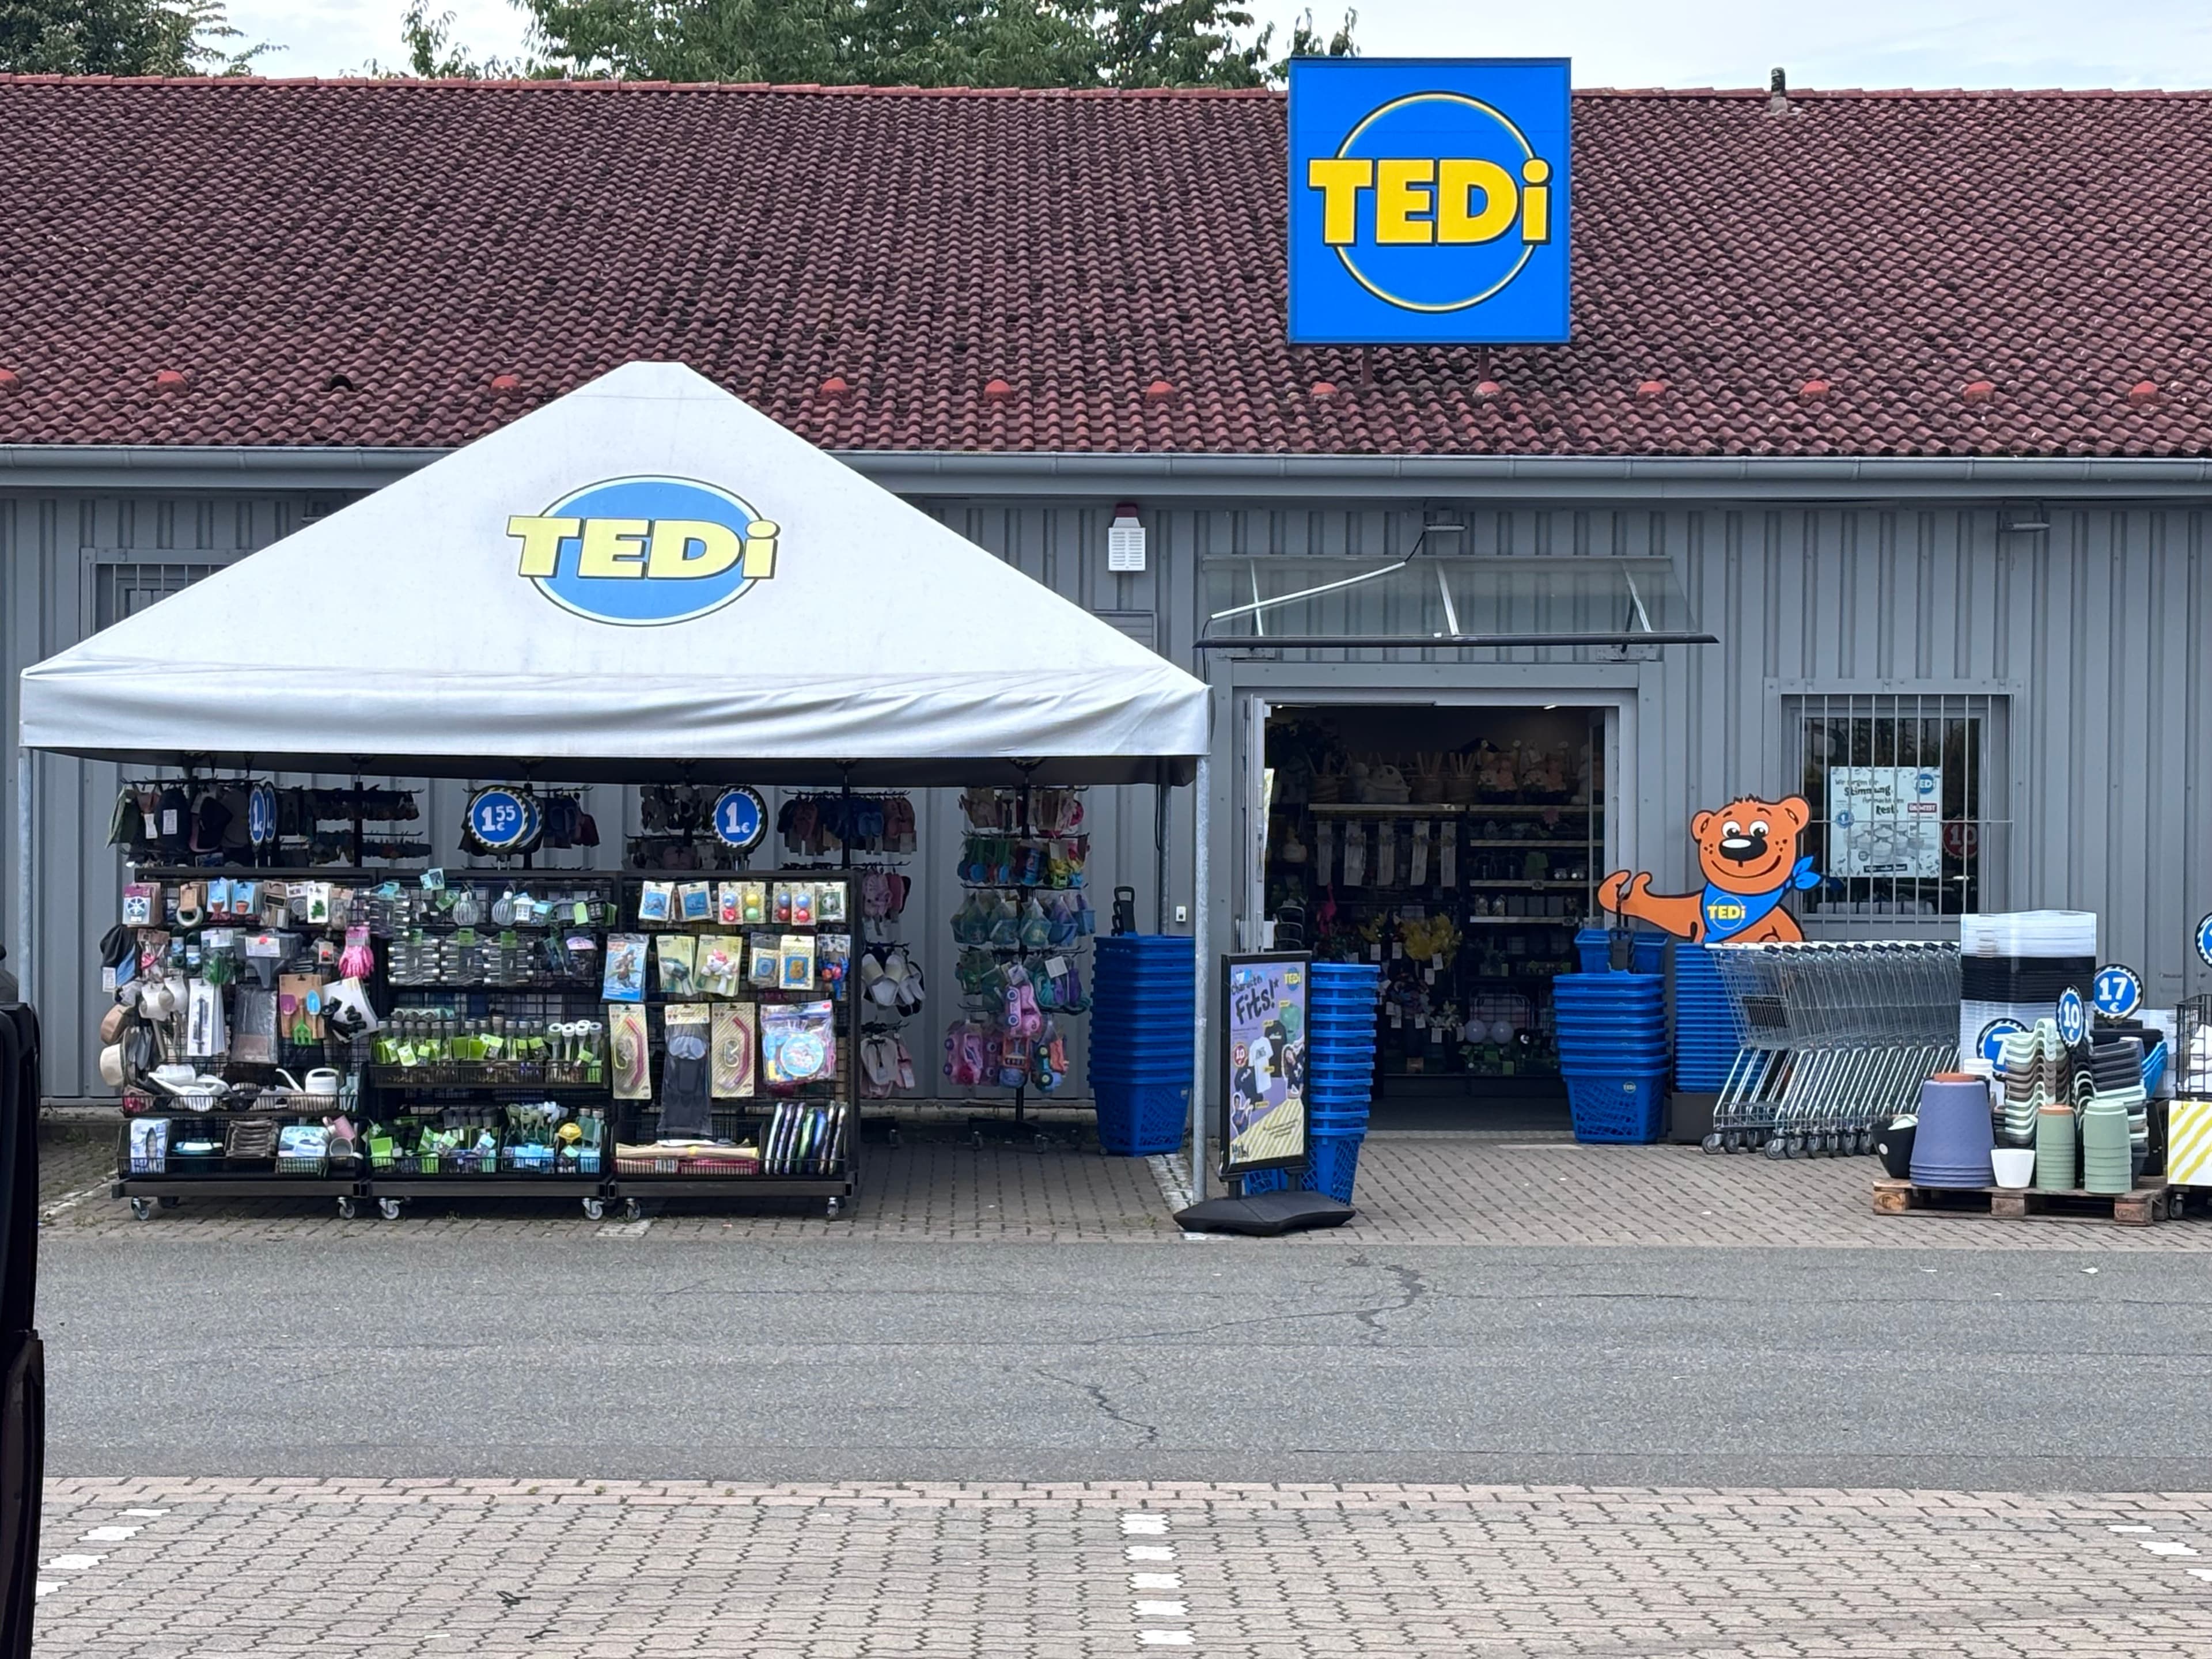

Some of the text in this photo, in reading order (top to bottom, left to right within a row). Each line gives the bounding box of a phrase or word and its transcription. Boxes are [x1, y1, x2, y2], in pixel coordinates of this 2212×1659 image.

[1308, 158, 1553, 247] TEDi
[506, 515, 781, 579] TEDi
[1950, 824, 1978, 846] 10
[1707, 905, 1747, 921] TEDi
[2099, 977, 2128, 1001] 17
[2064, 1001, 2080, 1029] 10
